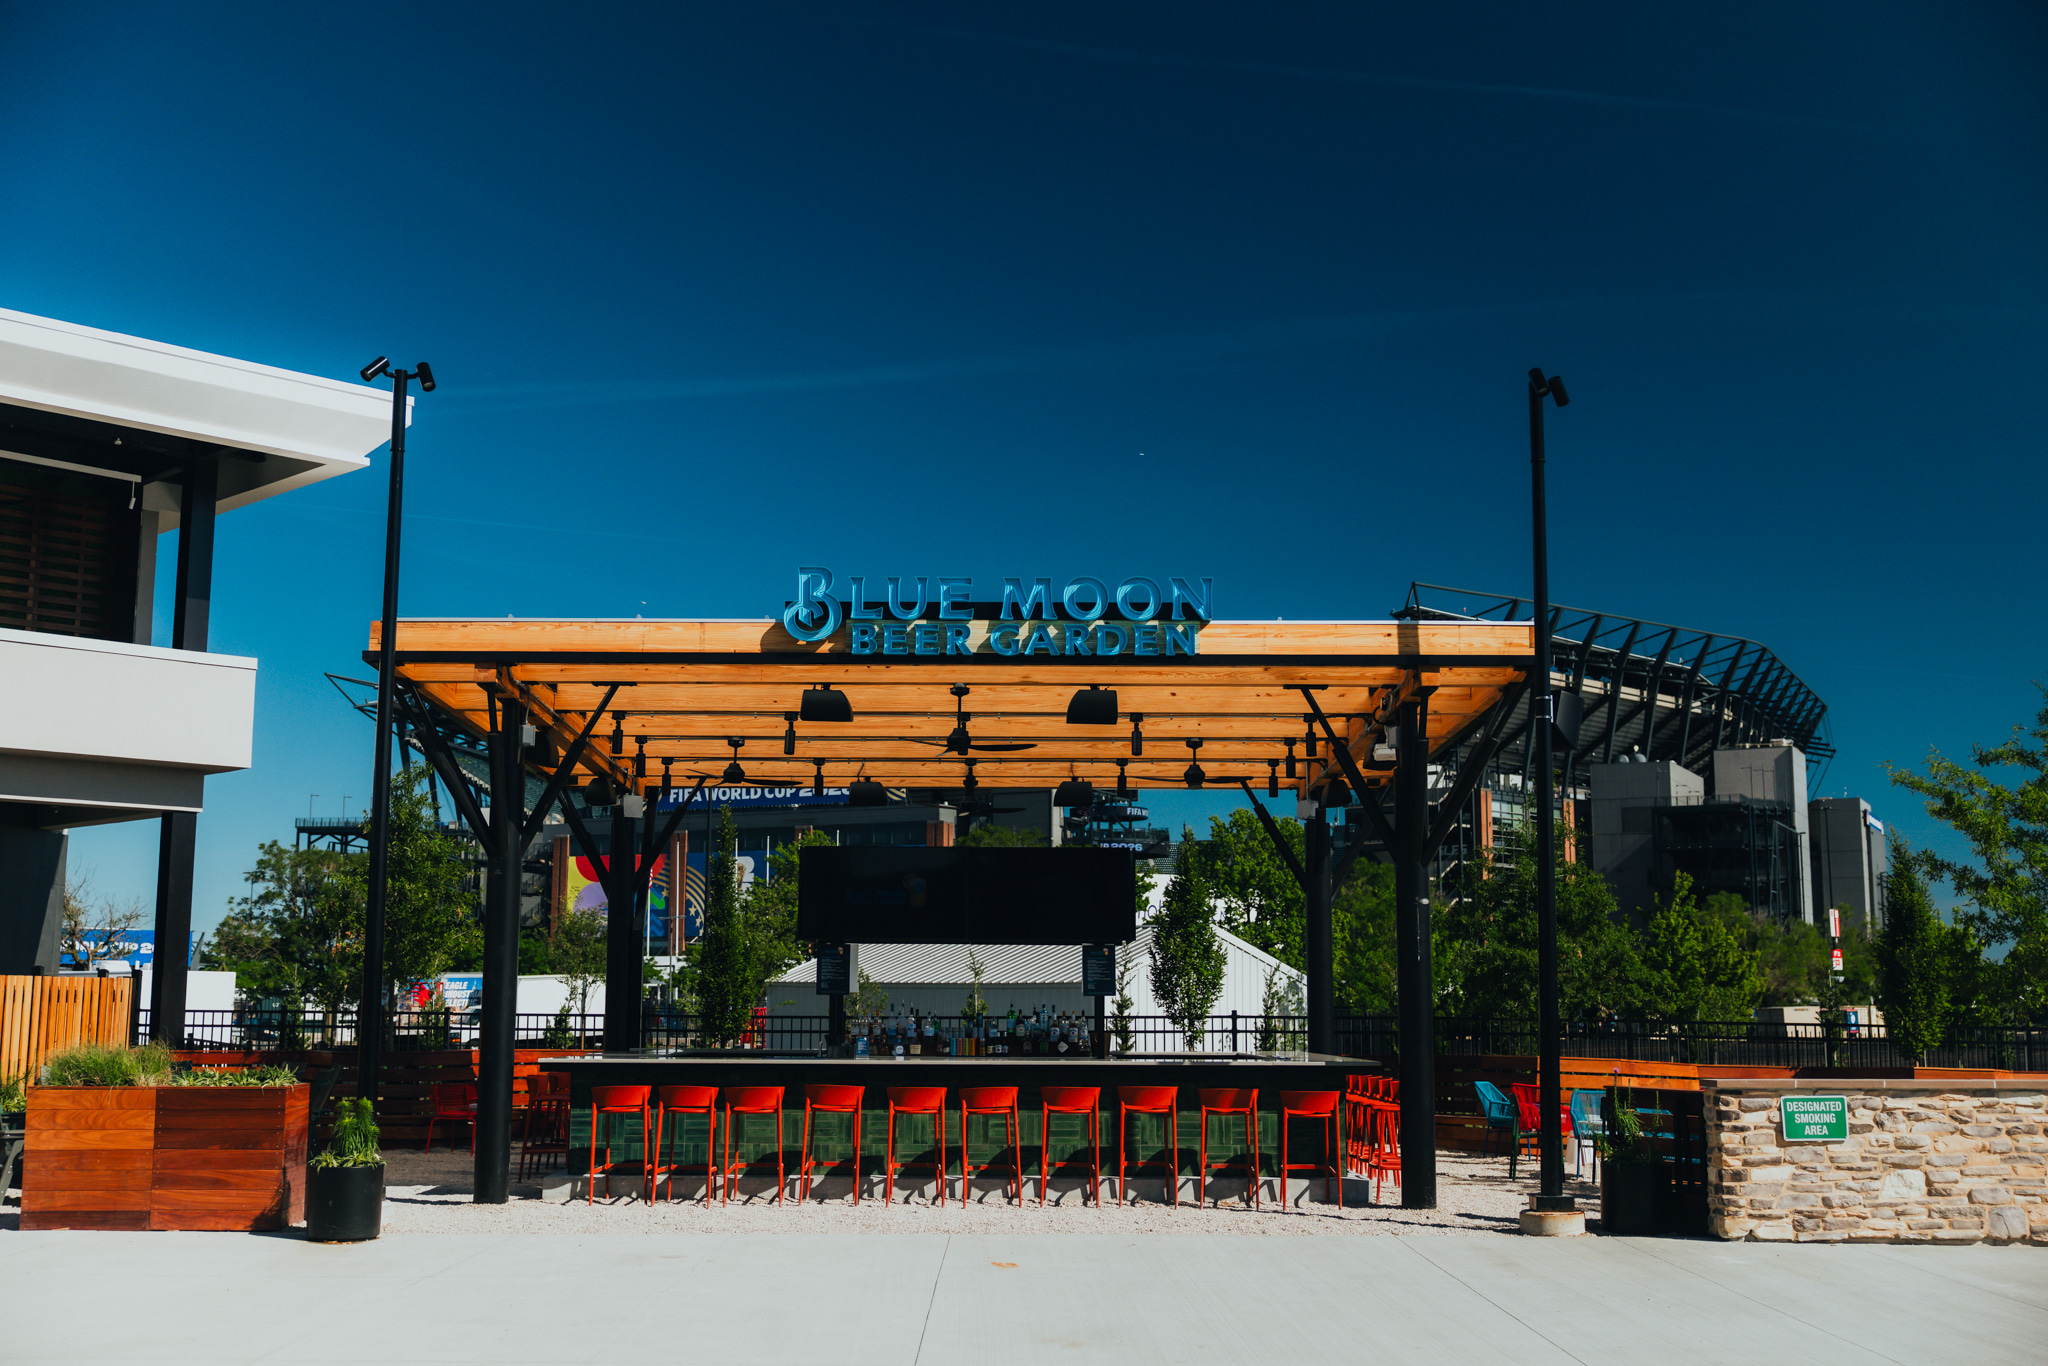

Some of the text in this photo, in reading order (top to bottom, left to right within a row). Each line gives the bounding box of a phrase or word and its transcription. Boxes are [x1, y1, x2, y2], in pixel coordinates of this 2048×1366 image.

[784, 566, 1214, 641] BLUE MOON
[851, 623, 1197, 656] BEER GARDEN
[670, 788, 702, 803] FIFA
[704, 788, 762, 801] WORLD
[764, 788, 796, 799] CUP
[1127, 807, 1141, 816] FIFA
[445, 981, 468, 989] EAGLE
[444, 990, 481, 998] INDUSTRIA
[445, 999, 478, 1007] ELECTRIC
[1786, 1101, 1842, 1112] DESIGNATED
[1794, 1113, 1836, 1123] SMOKING
[1804, 1125, 1829, 1135] AREA
